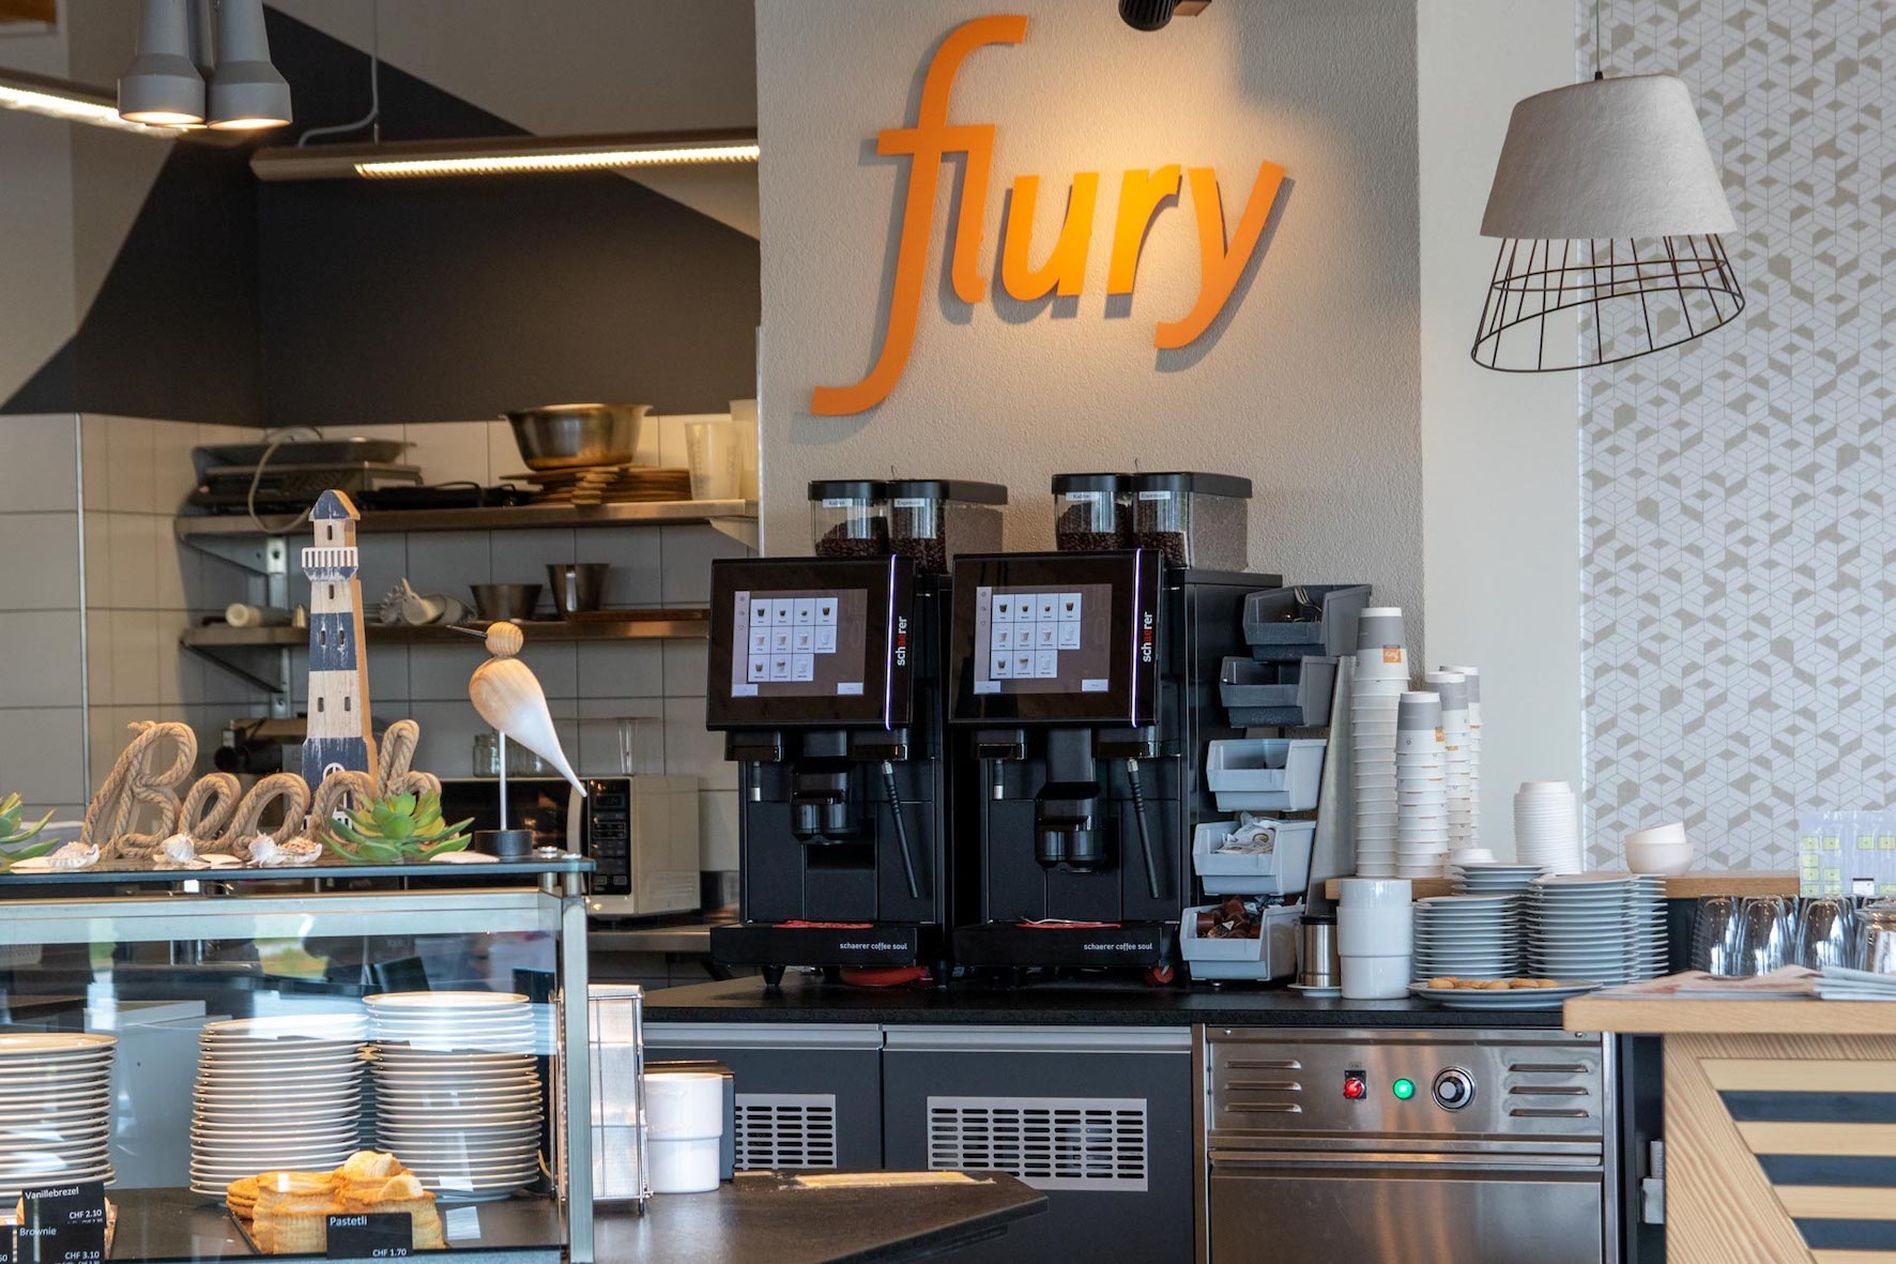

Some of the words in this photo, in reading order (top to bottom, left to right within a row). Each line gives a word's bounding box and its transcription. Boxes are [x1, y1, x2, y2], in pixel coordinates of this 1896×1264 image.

[810, 14, 1286, 416] flury
[840, 942, 870, 950] schaerer
[871, 942, 891, 950] coffee
[892, 942, 908, 950] soul
[1083, 942, 1114, 950] schaerer
[1115, 942, 1136, 951] coffee
[1137, 942, 1153, 950] soul
[25, 1186, 79, 1199] Vanillebrezel
[69, 1211, 84, 1219] CHF
[85, 1209, 102, 1218] 2.10
[329, 1215, 368, 1226] Pastetli
[19, 1226, 57, 1236] Brownie
[64, 1252, 80, 1260] CHF
[82, 1251, 100, 1260] 3.10
[372, 1248, 388, 1257] CHF
[390, 1247, 407, 1257] 1.70
